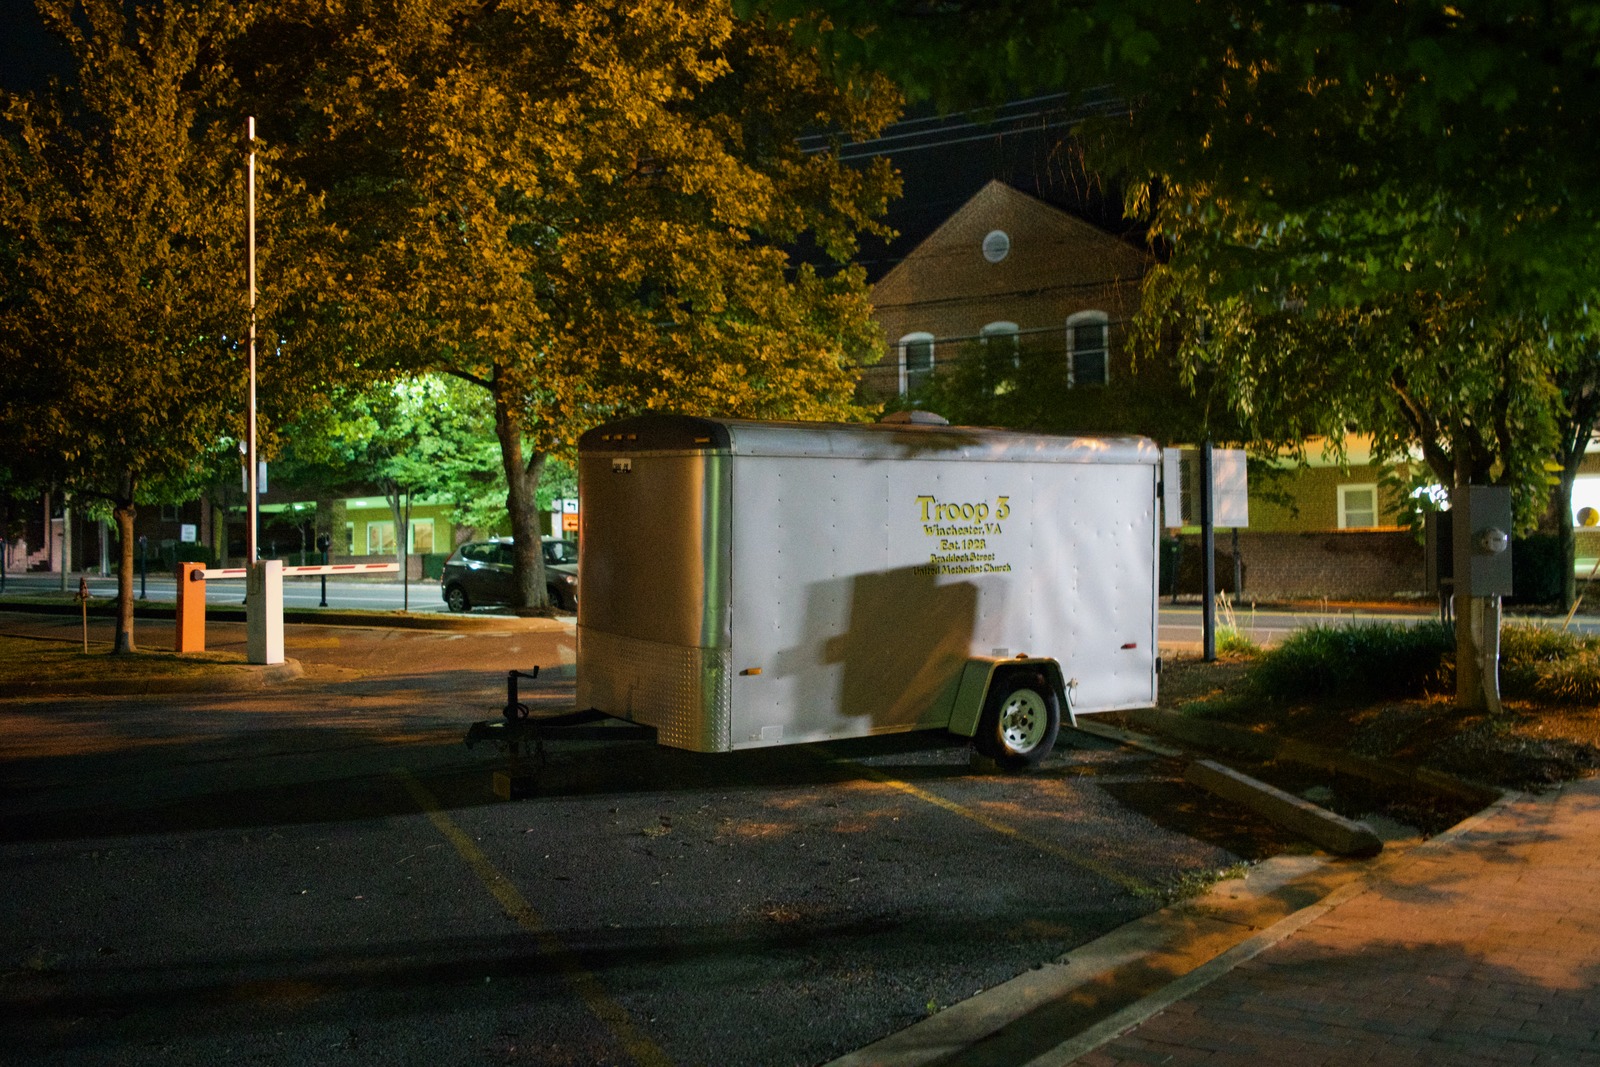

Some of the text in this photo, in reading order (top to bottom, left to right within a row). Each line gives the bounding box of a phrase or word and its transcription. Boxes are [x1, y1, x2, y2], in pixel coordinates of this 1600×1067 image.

[914, 495, 989, 525] Troop
[969, 552, 995, 562] Street
[941, 564, 983, 575] Methodist
[983, 562, 1012, 573] Church
